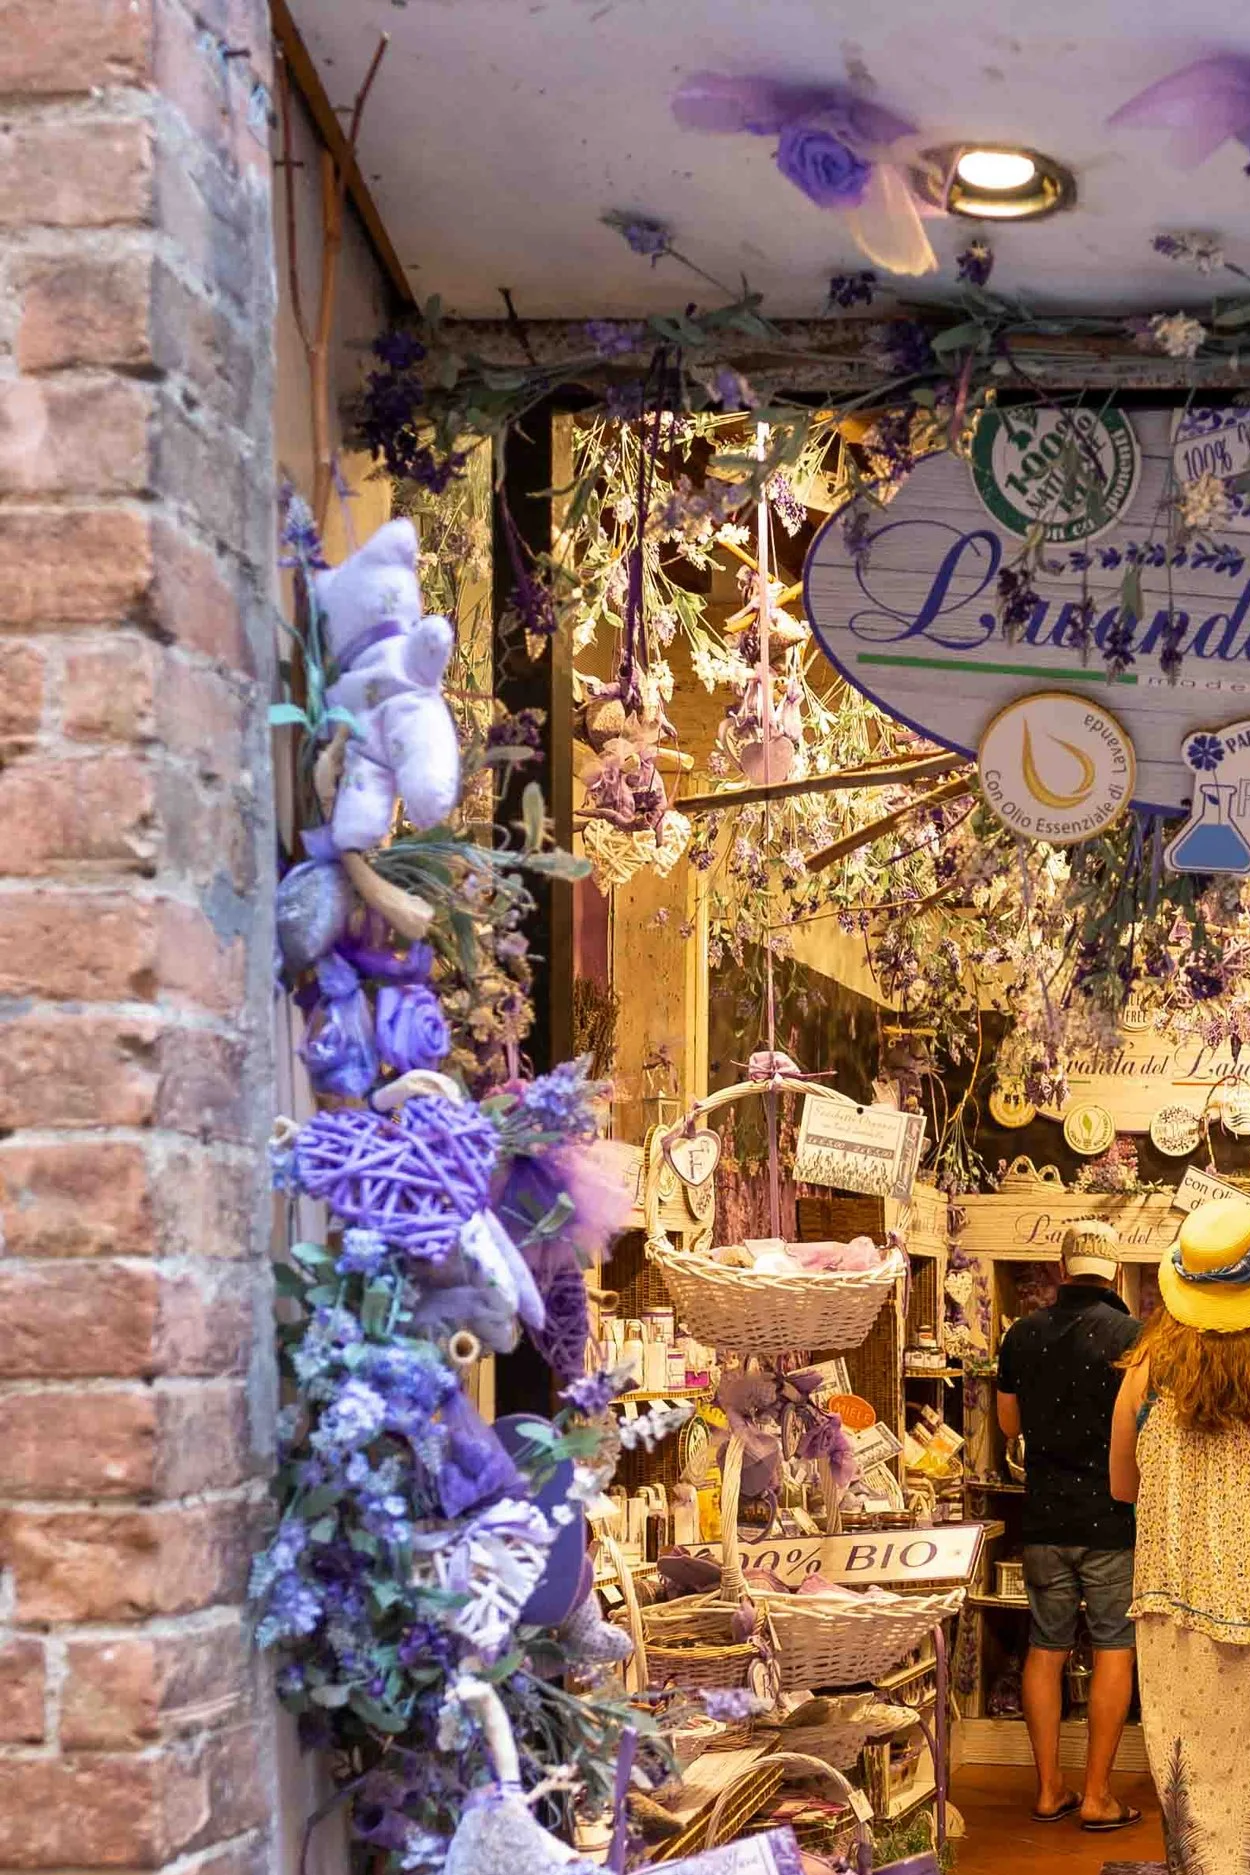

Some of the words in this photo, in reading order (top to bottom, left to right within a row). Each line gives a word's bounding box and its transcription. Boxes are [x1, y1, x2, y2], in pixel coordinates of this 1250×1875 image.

[1183, 437, 1232, 481] 100%
[1083, 713, 1127, 774] Lavanda
[985, 768, 1004, 802] Con
[1108, 783, 1125, 801] di
[1001, 801, 1032, 829] Olio
[1035, 801, 1115, 834] Essenziale
[1140, 1055, 1169, 1076] del
[1184, 1176, 1209, 1195] con
[1128, 1226, 1151, 1245] del
[835, 1401, 871, 1421] MIELE
[844, 1539, 938, 1571] BIO
